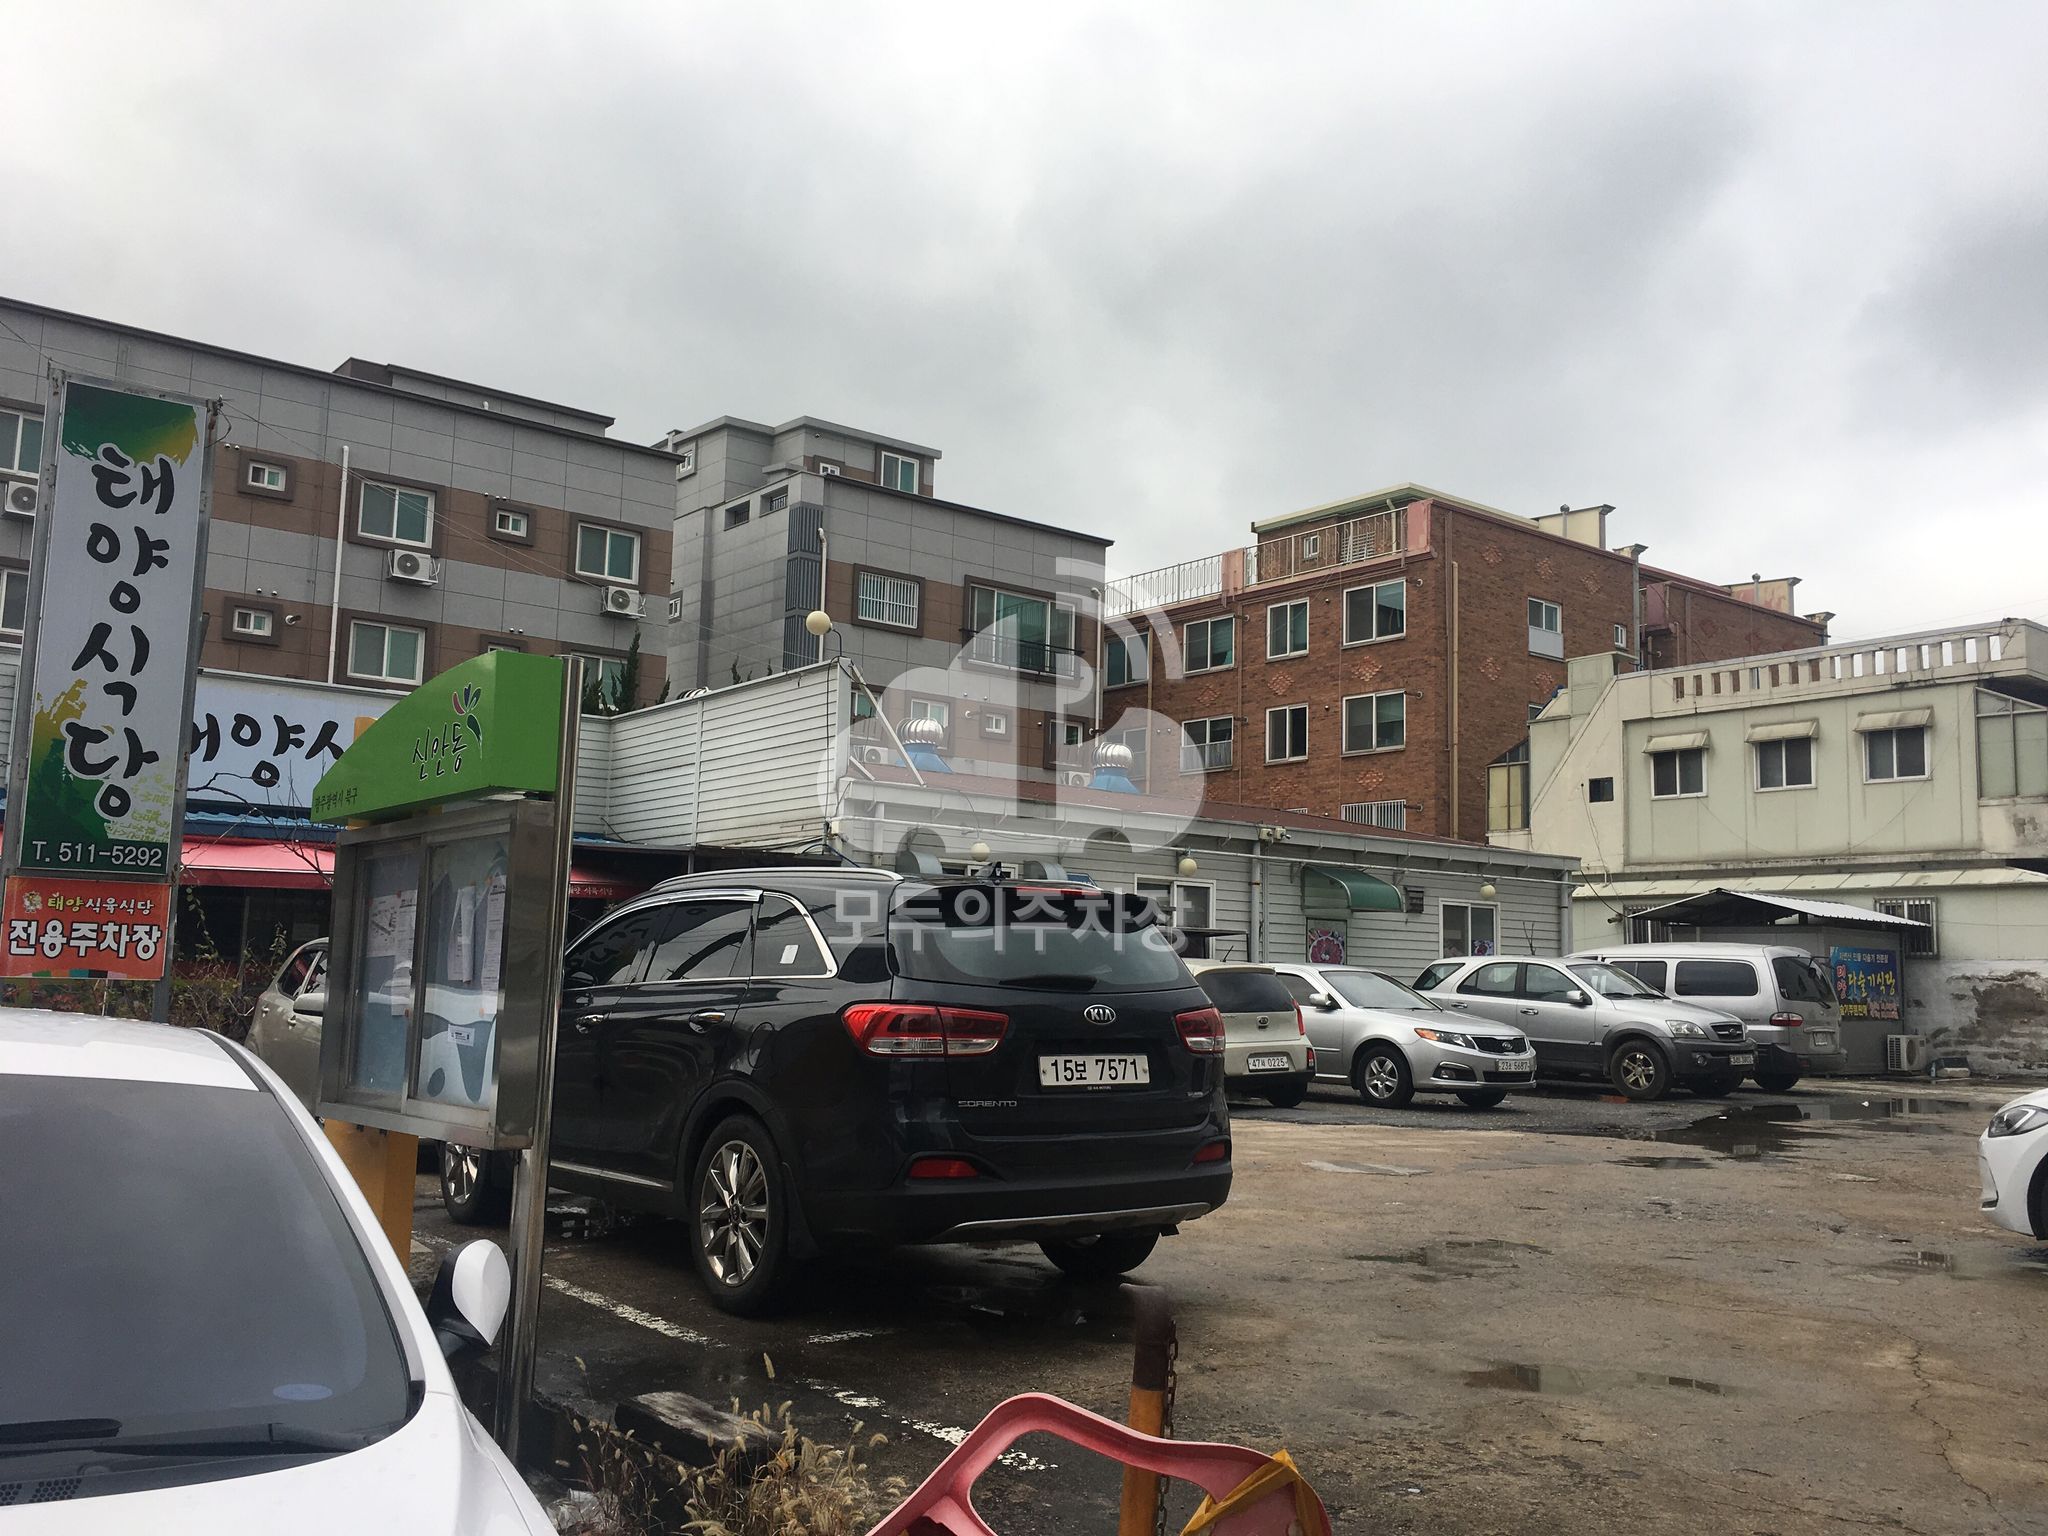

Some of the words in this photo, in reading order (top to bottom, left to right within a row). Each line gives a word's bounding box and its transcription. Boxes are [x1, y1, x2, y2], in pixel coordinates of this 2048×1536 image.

[70, 446, 175, 818] 태양식당
[412, 721, 467, 781] 신안동
[345, 787, 358, 805] 북구
[32, 841, 50, 862] T.
[58, 842, 162, 867] 511-5292
[47, 895, 155, 915] 태양식육식당
[9, 919, 162, 961] 전용주차장
[1088, 1007, 1113, 1022] KIA
[1051, 1059, 1087, 1082] 15보
[1095, 1058, 1139, 1081] 7571
[1267, 1057, 1285, 1067] 0225
[958, 1100, 1018, 1108] SORENTO
